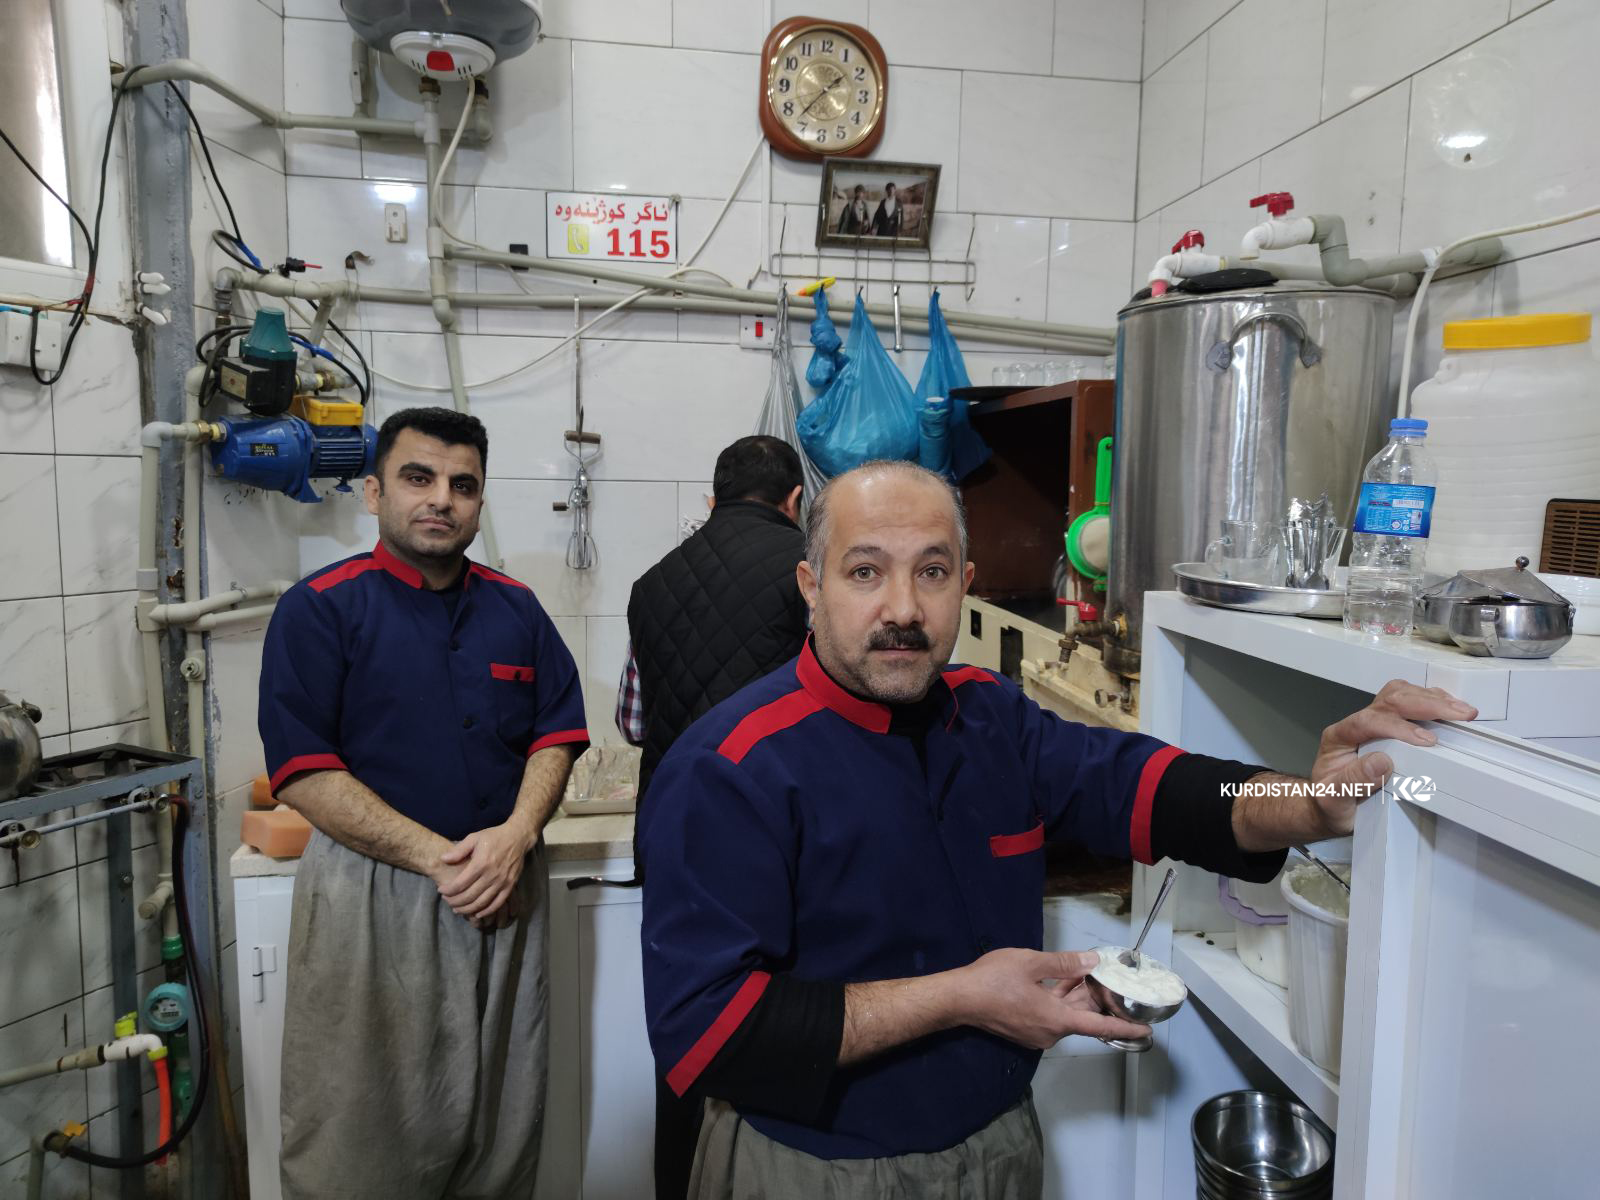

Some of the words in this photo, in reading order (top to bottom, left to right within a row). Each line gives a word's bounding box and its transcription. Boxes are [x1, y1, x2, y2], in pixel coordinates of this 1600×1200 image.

[801, 42, 812, 56] 11
[821, 39, 834, 53] 12
[843, 48, 849, 62] 1
[785, 56, 798, 71] 10
[854, 67, 865, 81] 2
[779, 78, 790, 93] 9
[858, 90, 869, 104] 3
[783, 101, 794, 116] 8
[850, 111, 860, 125] 4
[797, 121, 808, 132] 7
[836, 125, 846, 140] 5
[816, 128, 827, 143] 6
[607, 227, 670, 258] 115
